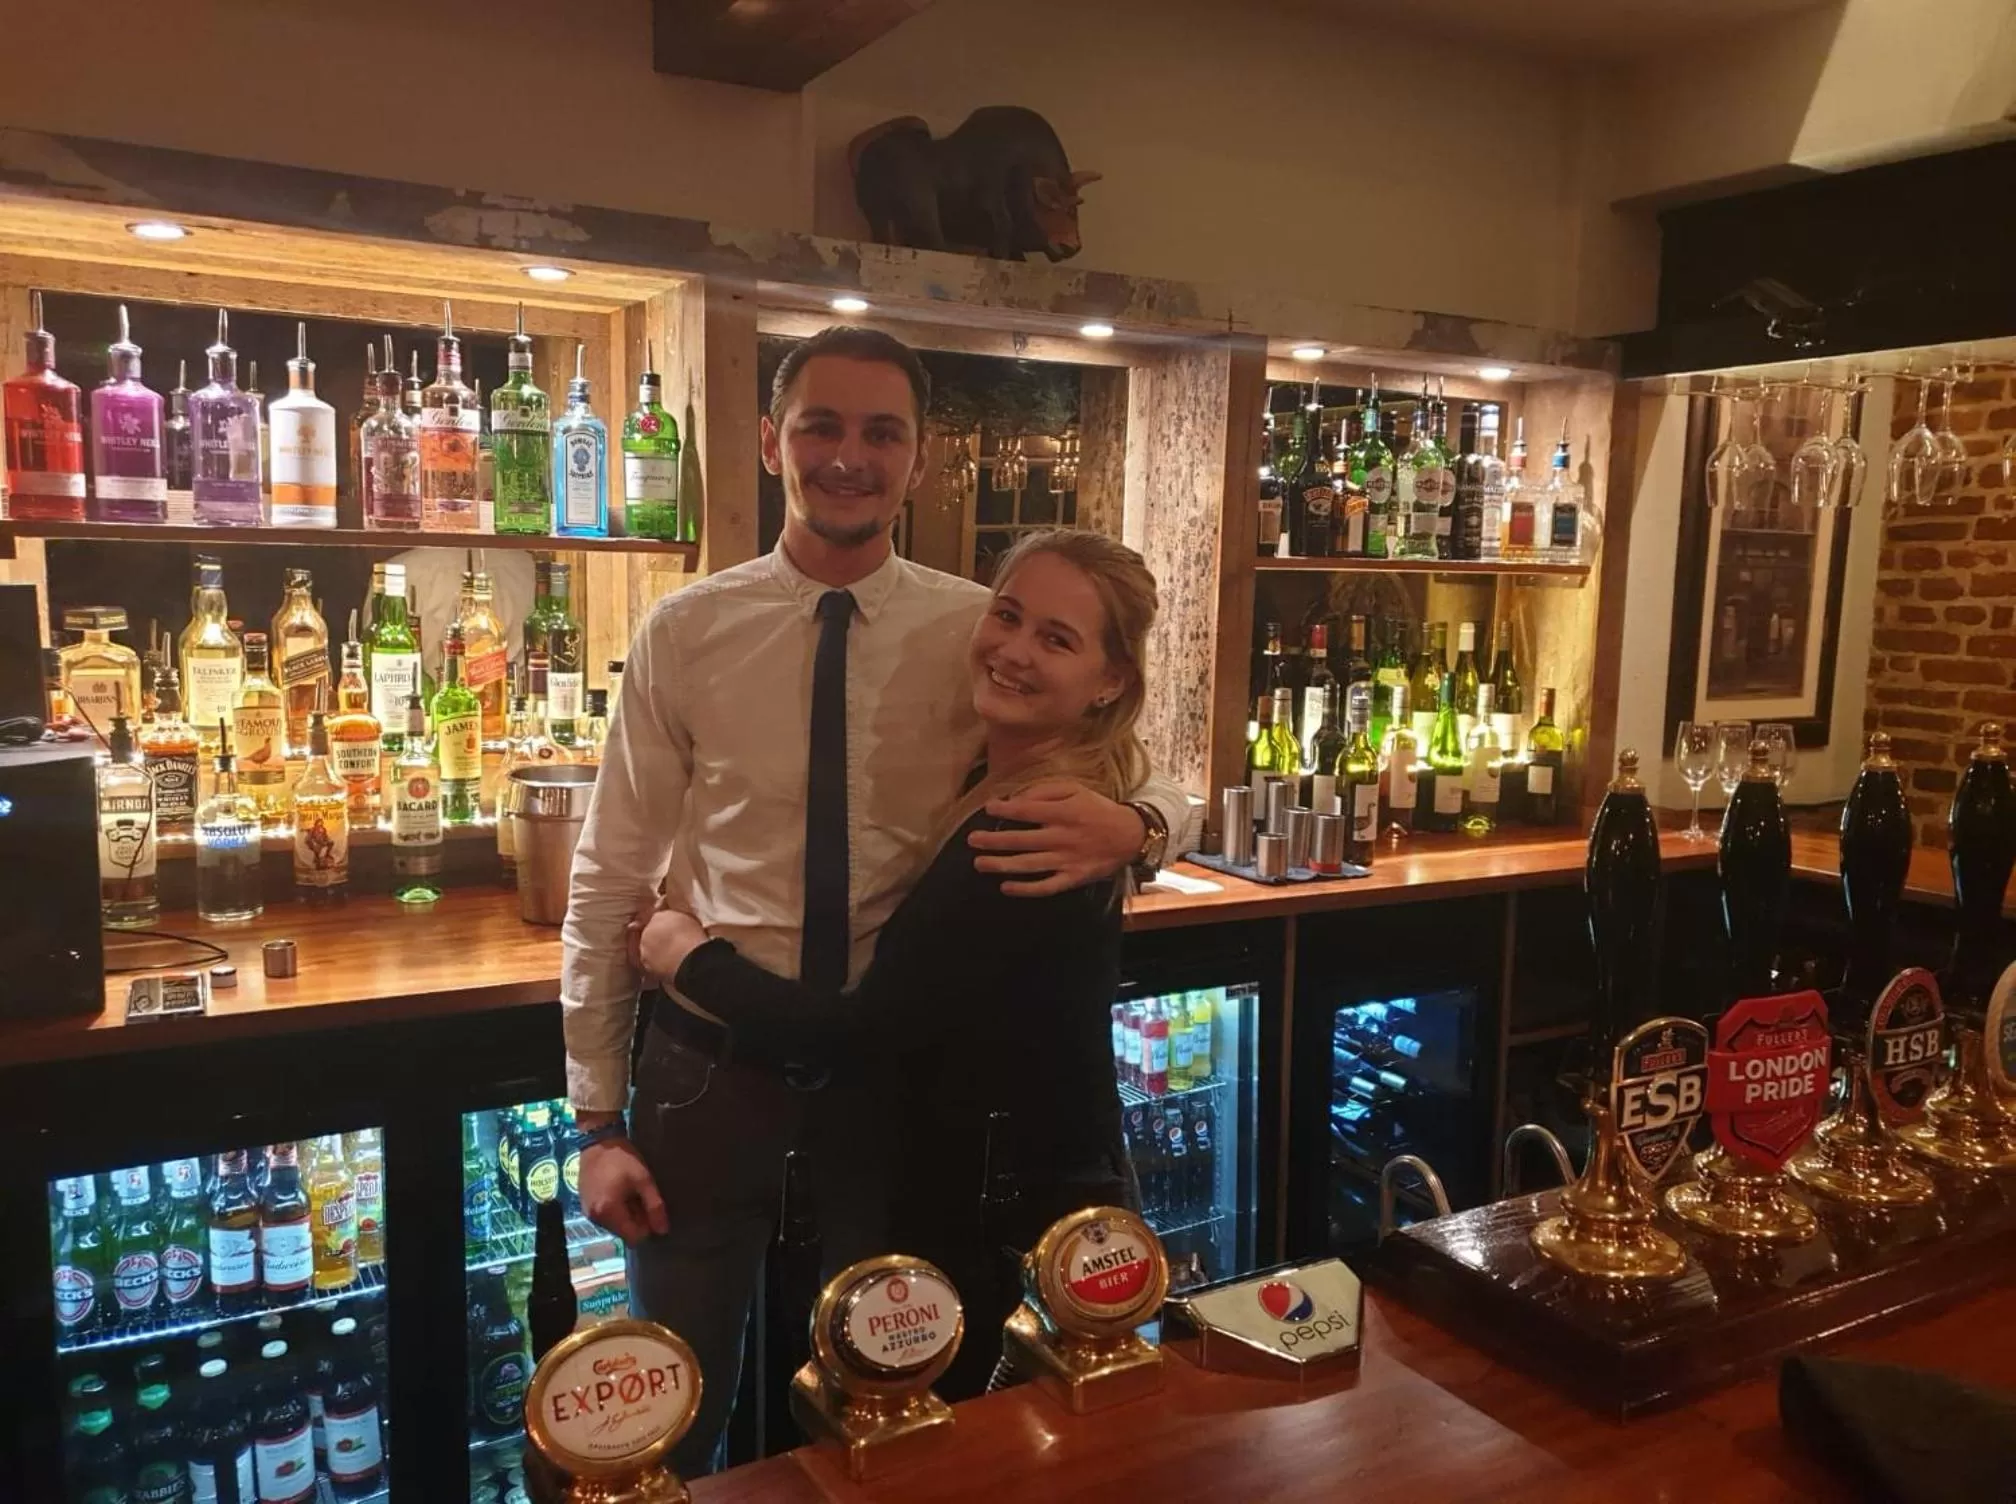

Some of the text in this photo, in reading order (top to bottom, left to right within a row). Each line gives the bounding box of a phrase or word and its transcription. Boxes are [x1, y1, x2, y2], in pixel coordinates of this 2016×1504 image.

[374, 672, 412, 683] LAPHRO
[445, 719, 478, 735] JAME
[336, 747, 377, 758] SOUTHERN
[339, 759, 376, 769] COMFORT
[101, 799, 153, 811] MIRNOF
[397, 800, 437, 812] BACARD
[1883, 1028, 1939, 1066] HSB
[1728, 1046, 1828, 1082] LONDON
[1745, 1073, 1816, 1104] PRIDE
[1620, 1071, 1702, 1130] ESB
[1082, 1246, 1137, 1277] AMSTEL
[1099, 1271, 1129, 1290] BIER
[868, 1303, 941, 1337] PERONI
[1279, 1310, 1354, 1351] pepsi
[881, 1331, 937, 1353] AZZURRO
